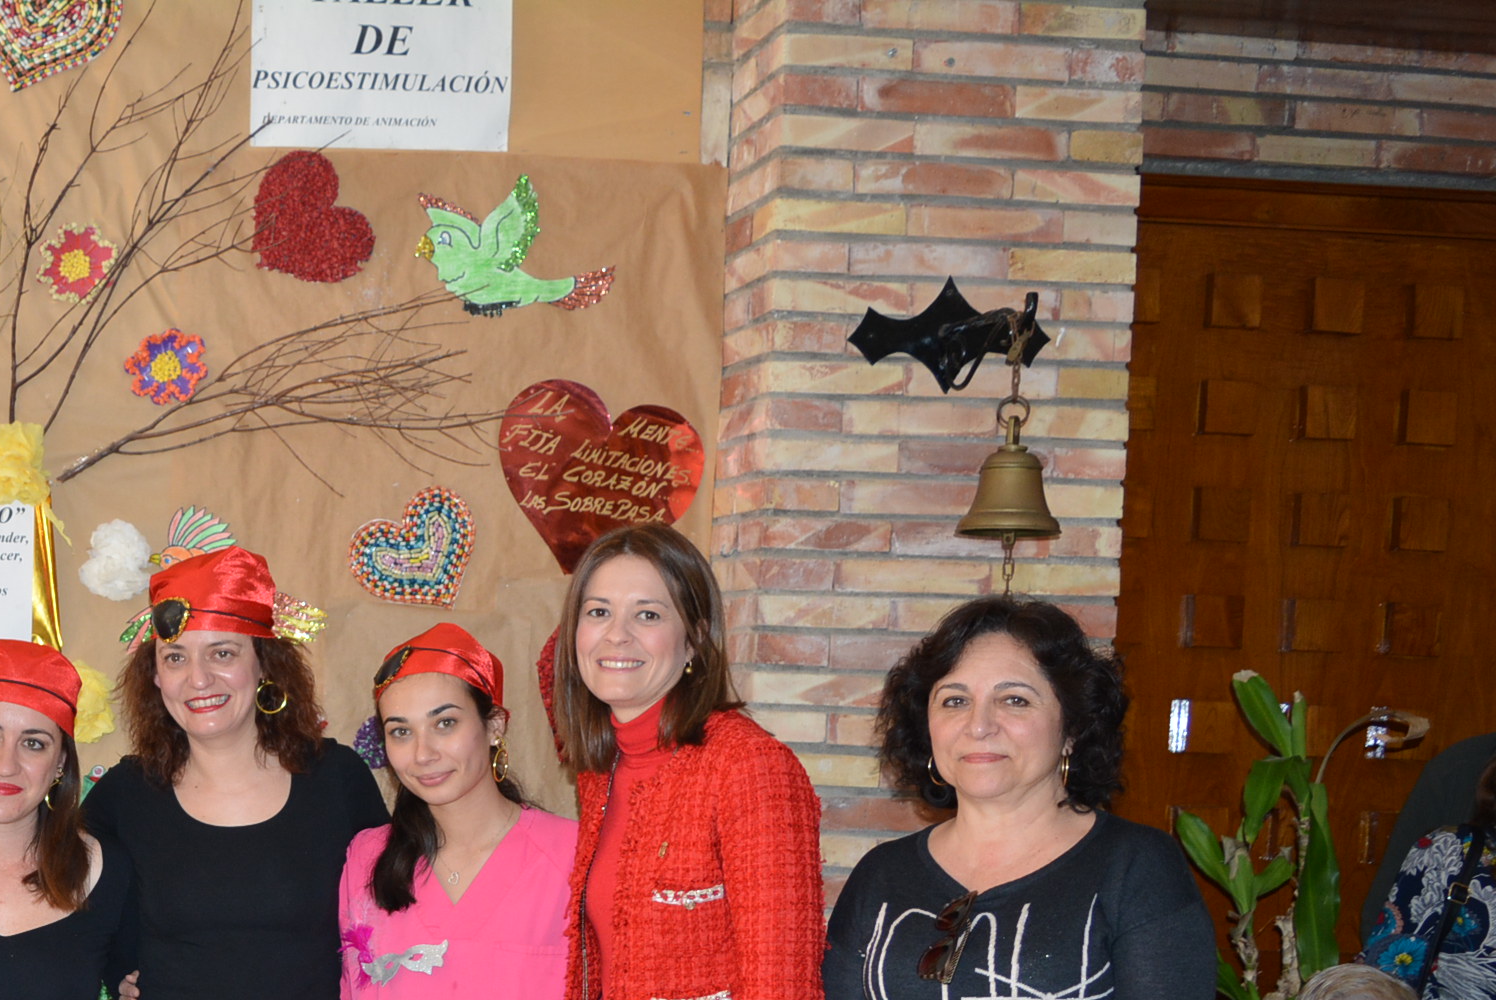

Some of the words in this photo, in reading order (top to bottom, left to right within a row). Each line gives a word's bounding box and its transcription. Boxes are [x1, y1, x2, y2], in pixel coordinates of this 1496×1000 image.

[351, 23, 414, 56] DE
[252, 69, 508, 94] PSICOESTIMULACIÓN
[262, 114, 352, 127] DEPARTAMENTO
[354, 116, 370, 127] DE
[372, 115, 438, 128] ANIMACIÓN
[528, 391, 570, 422] LA
[502, 424, 562, 455] FIJA
[519, 461, 550, 481] EL
[519, 490, 548, 510] LAS
